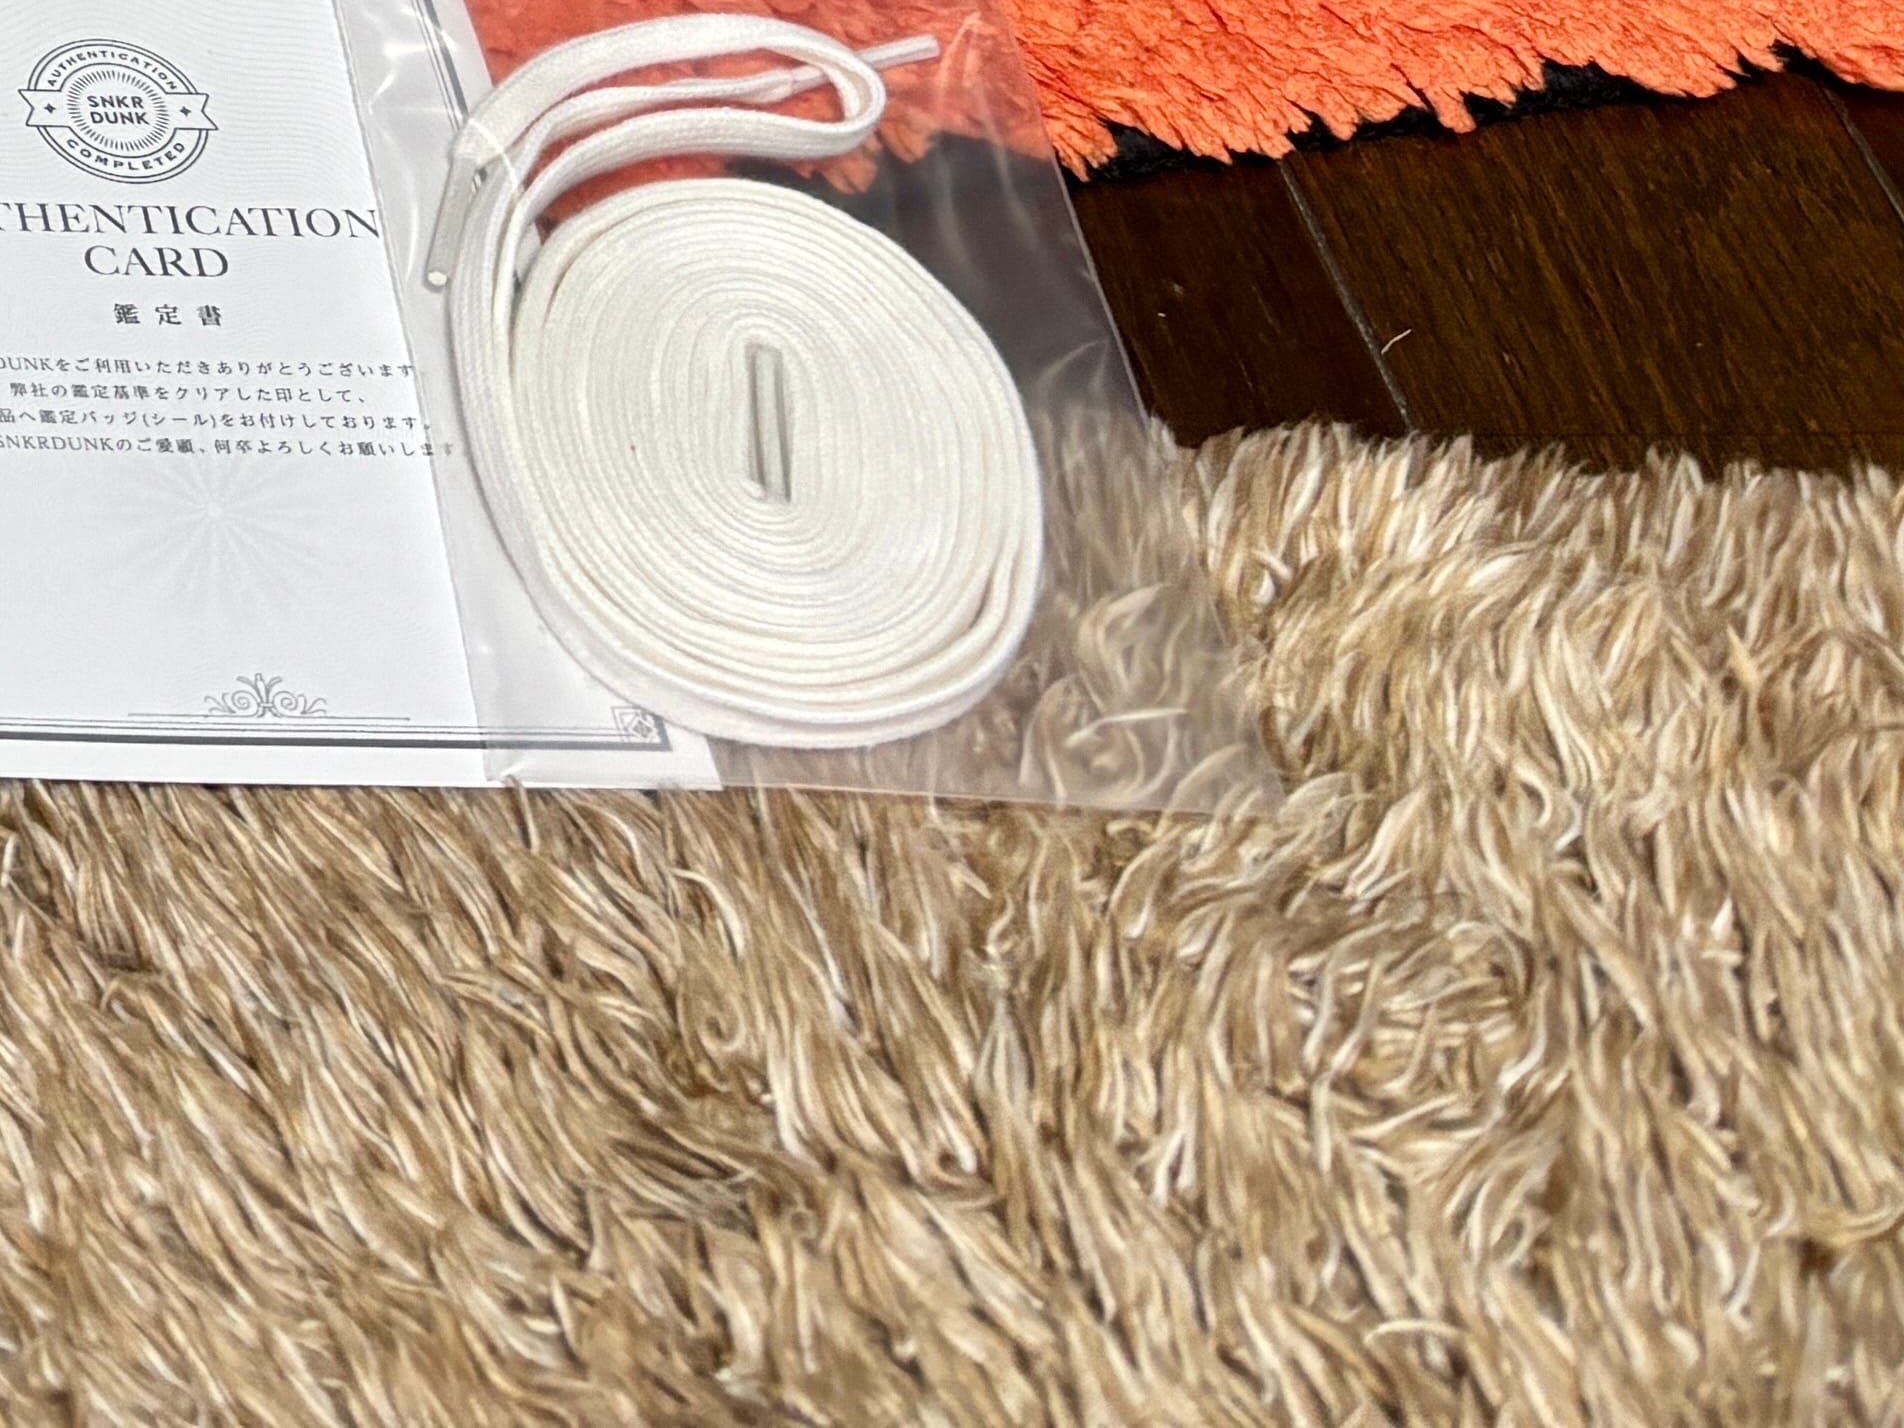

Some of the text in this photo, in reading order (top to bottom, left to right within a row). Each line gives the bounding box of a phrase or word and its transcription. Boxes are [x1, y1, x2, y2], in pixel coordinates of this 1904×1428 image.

[47, 50, 178, 91] AUTHENTICATION
[86, 94, 145, 110] SNKR
[90, 110, 150, 126] DUNK
[66, 138, 186, 171] COMPLETED
[84, 244, 230, 279] CARD
